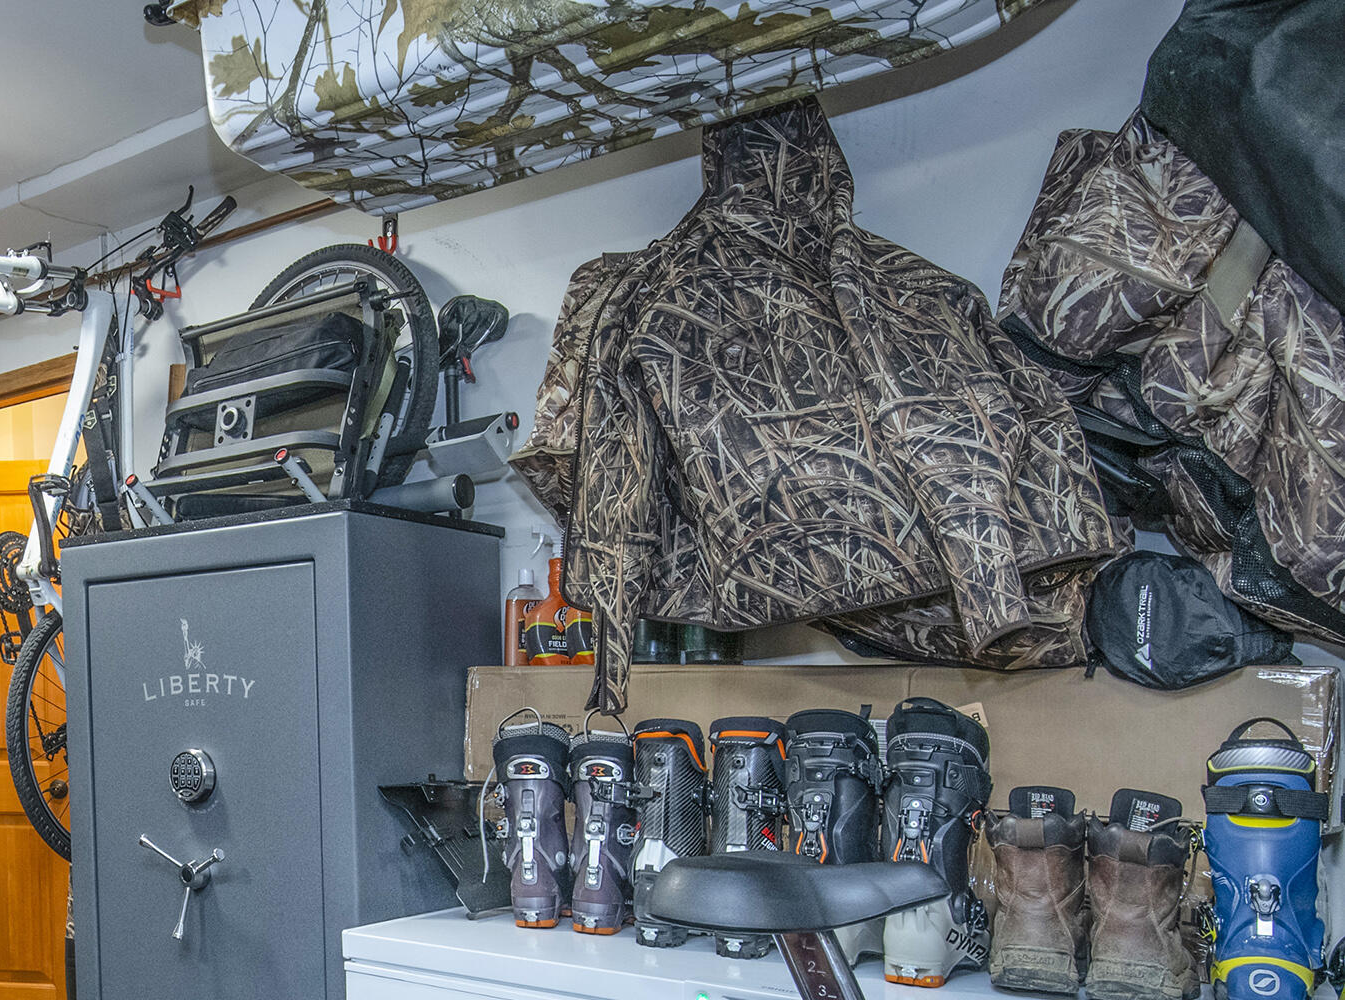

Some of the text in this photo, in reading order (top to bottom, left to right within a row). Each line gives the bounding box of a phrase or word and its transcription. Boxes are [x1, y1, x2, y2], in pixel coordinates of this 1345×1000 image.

[549, 640, 567, 648] FIELD
[143, 673, 255, 701] LIBERTY
[184, 699, 206, 707] SAFE
[761, 827, 776, 844] BLAC
[946, 928, 988, 960] DYNA
